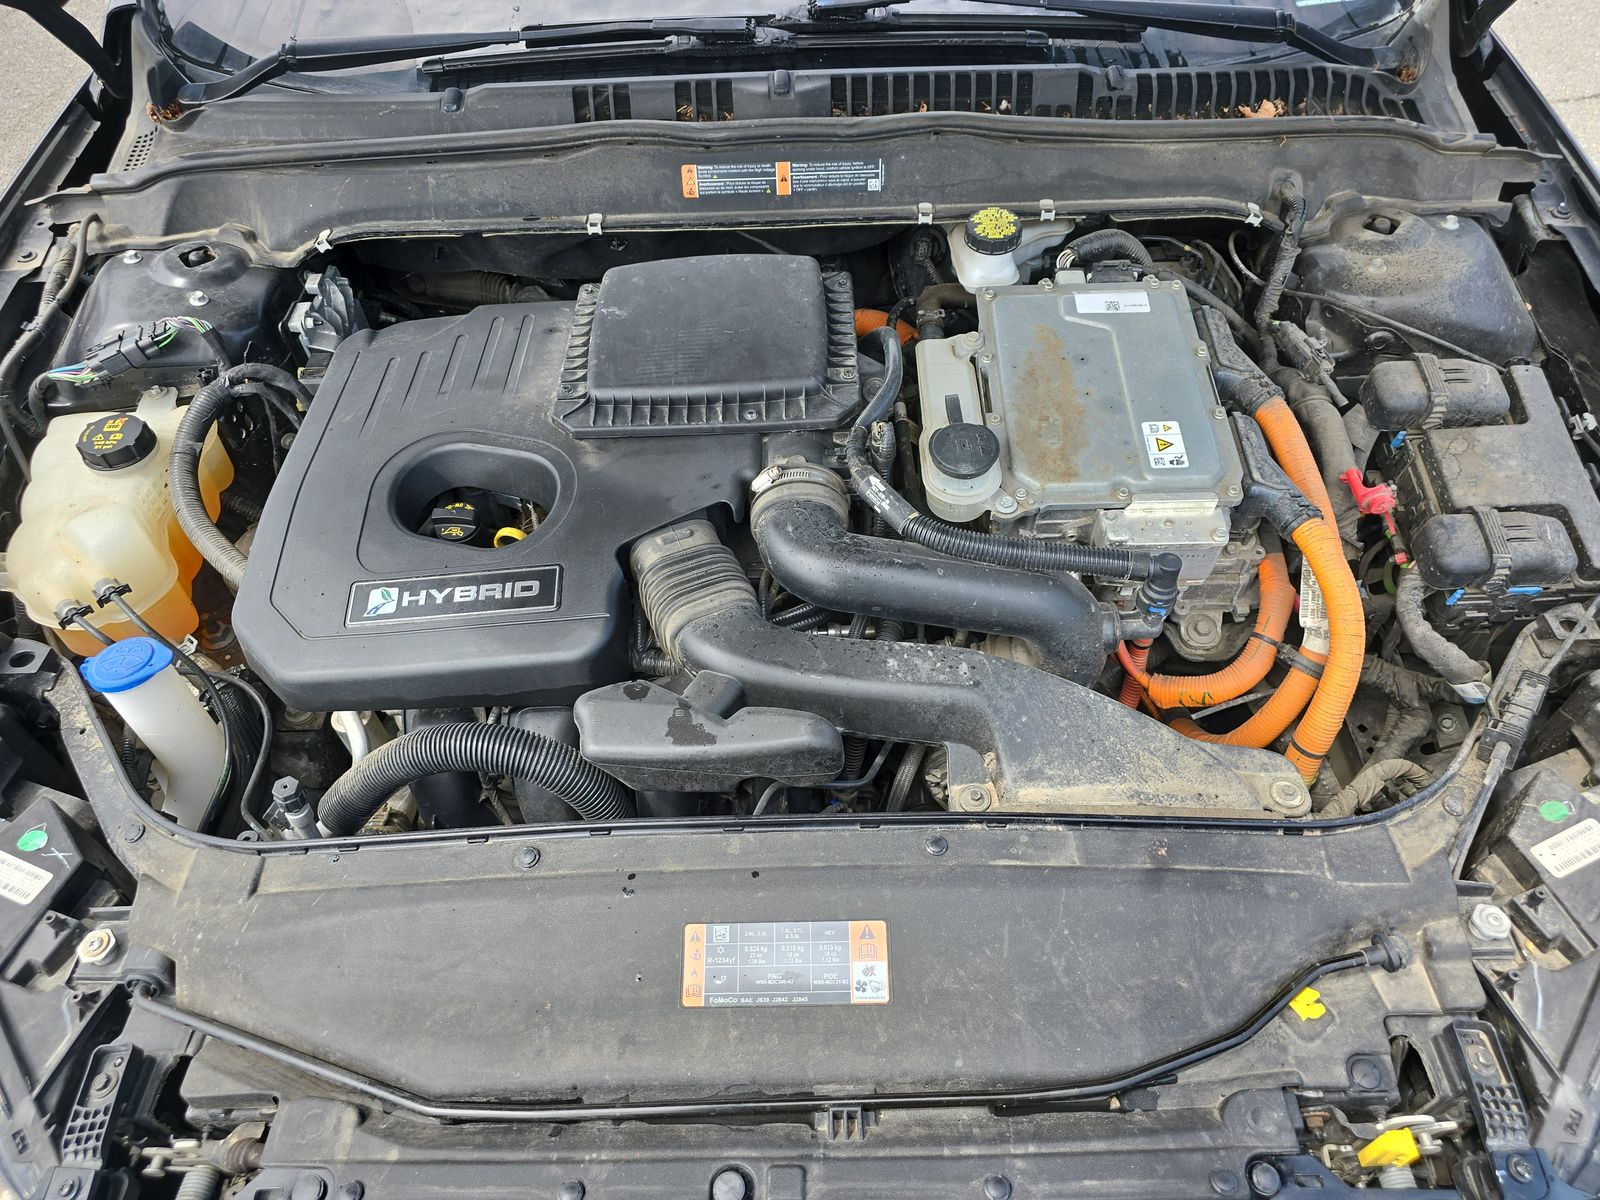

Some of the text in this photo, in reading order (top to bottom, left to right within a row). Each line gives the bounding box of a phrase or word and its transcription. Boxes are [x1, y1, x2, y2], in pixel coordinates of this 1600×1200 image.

[402, 580, 540, 606] HYBRID
[760, 945, 768, 953] kg
[708, 957, 735, 965] R-1234yf
